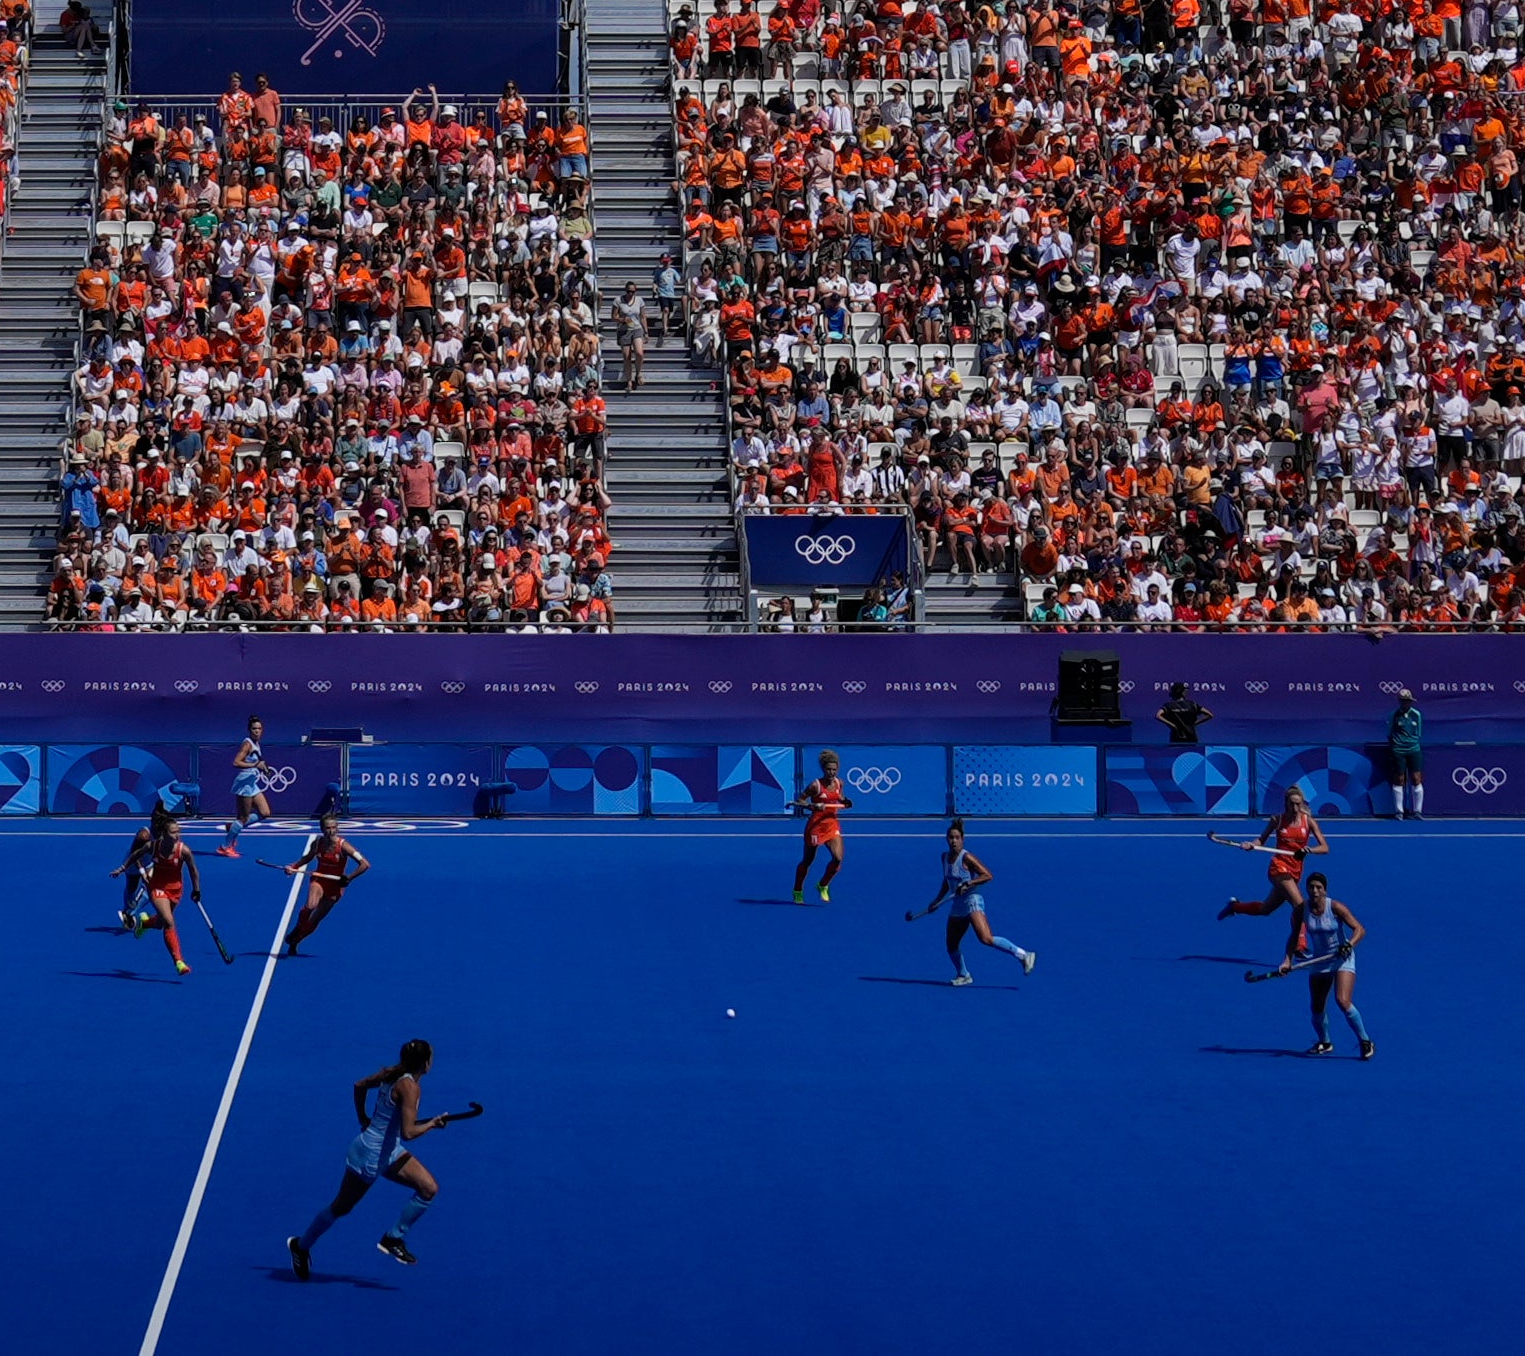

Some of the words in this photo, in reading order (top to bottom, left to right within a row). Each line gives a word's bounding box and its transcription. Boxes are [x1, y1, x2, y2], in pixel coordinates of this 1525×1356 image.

[85, 682, 119, 690] PARIS
[123, 682, 155, 690] 2024
[218, 682, 252, 690] PARIS
[257, 682, 288, 690] 2024
[351, 683, 386, 691] PARIS
[390, 683, 422, 691] 2024
[485, 684, 519, 692] PARIS
[524, 684, 555, 692] 2024
[618, 683, 653, 691] PARIS
[657, 683, 689, 691] 2024
[752, 683, 786, 691] PARIS
[791, 683, 822, 691] 2024
[886, 683, 921, 691] PARIS
[925, 682, 957, 691] 2024
[1020, 683, 1055, 691] PARIS
[1194, 683, 1225, 691] 2024
[1289, 683, 1323, 691] PARIS
[1328, 683, 1359, 691] 2024
[1423, 683, 1458, 691] PARIS
[1462, 683, 1494, 691] 2024
[362, 773, 418, 786] PARIS
[427, 773, 479, 786] 2024
[966, 774, 1023, 787] PARIS
[1032, 773, 1084, 787] 2024
